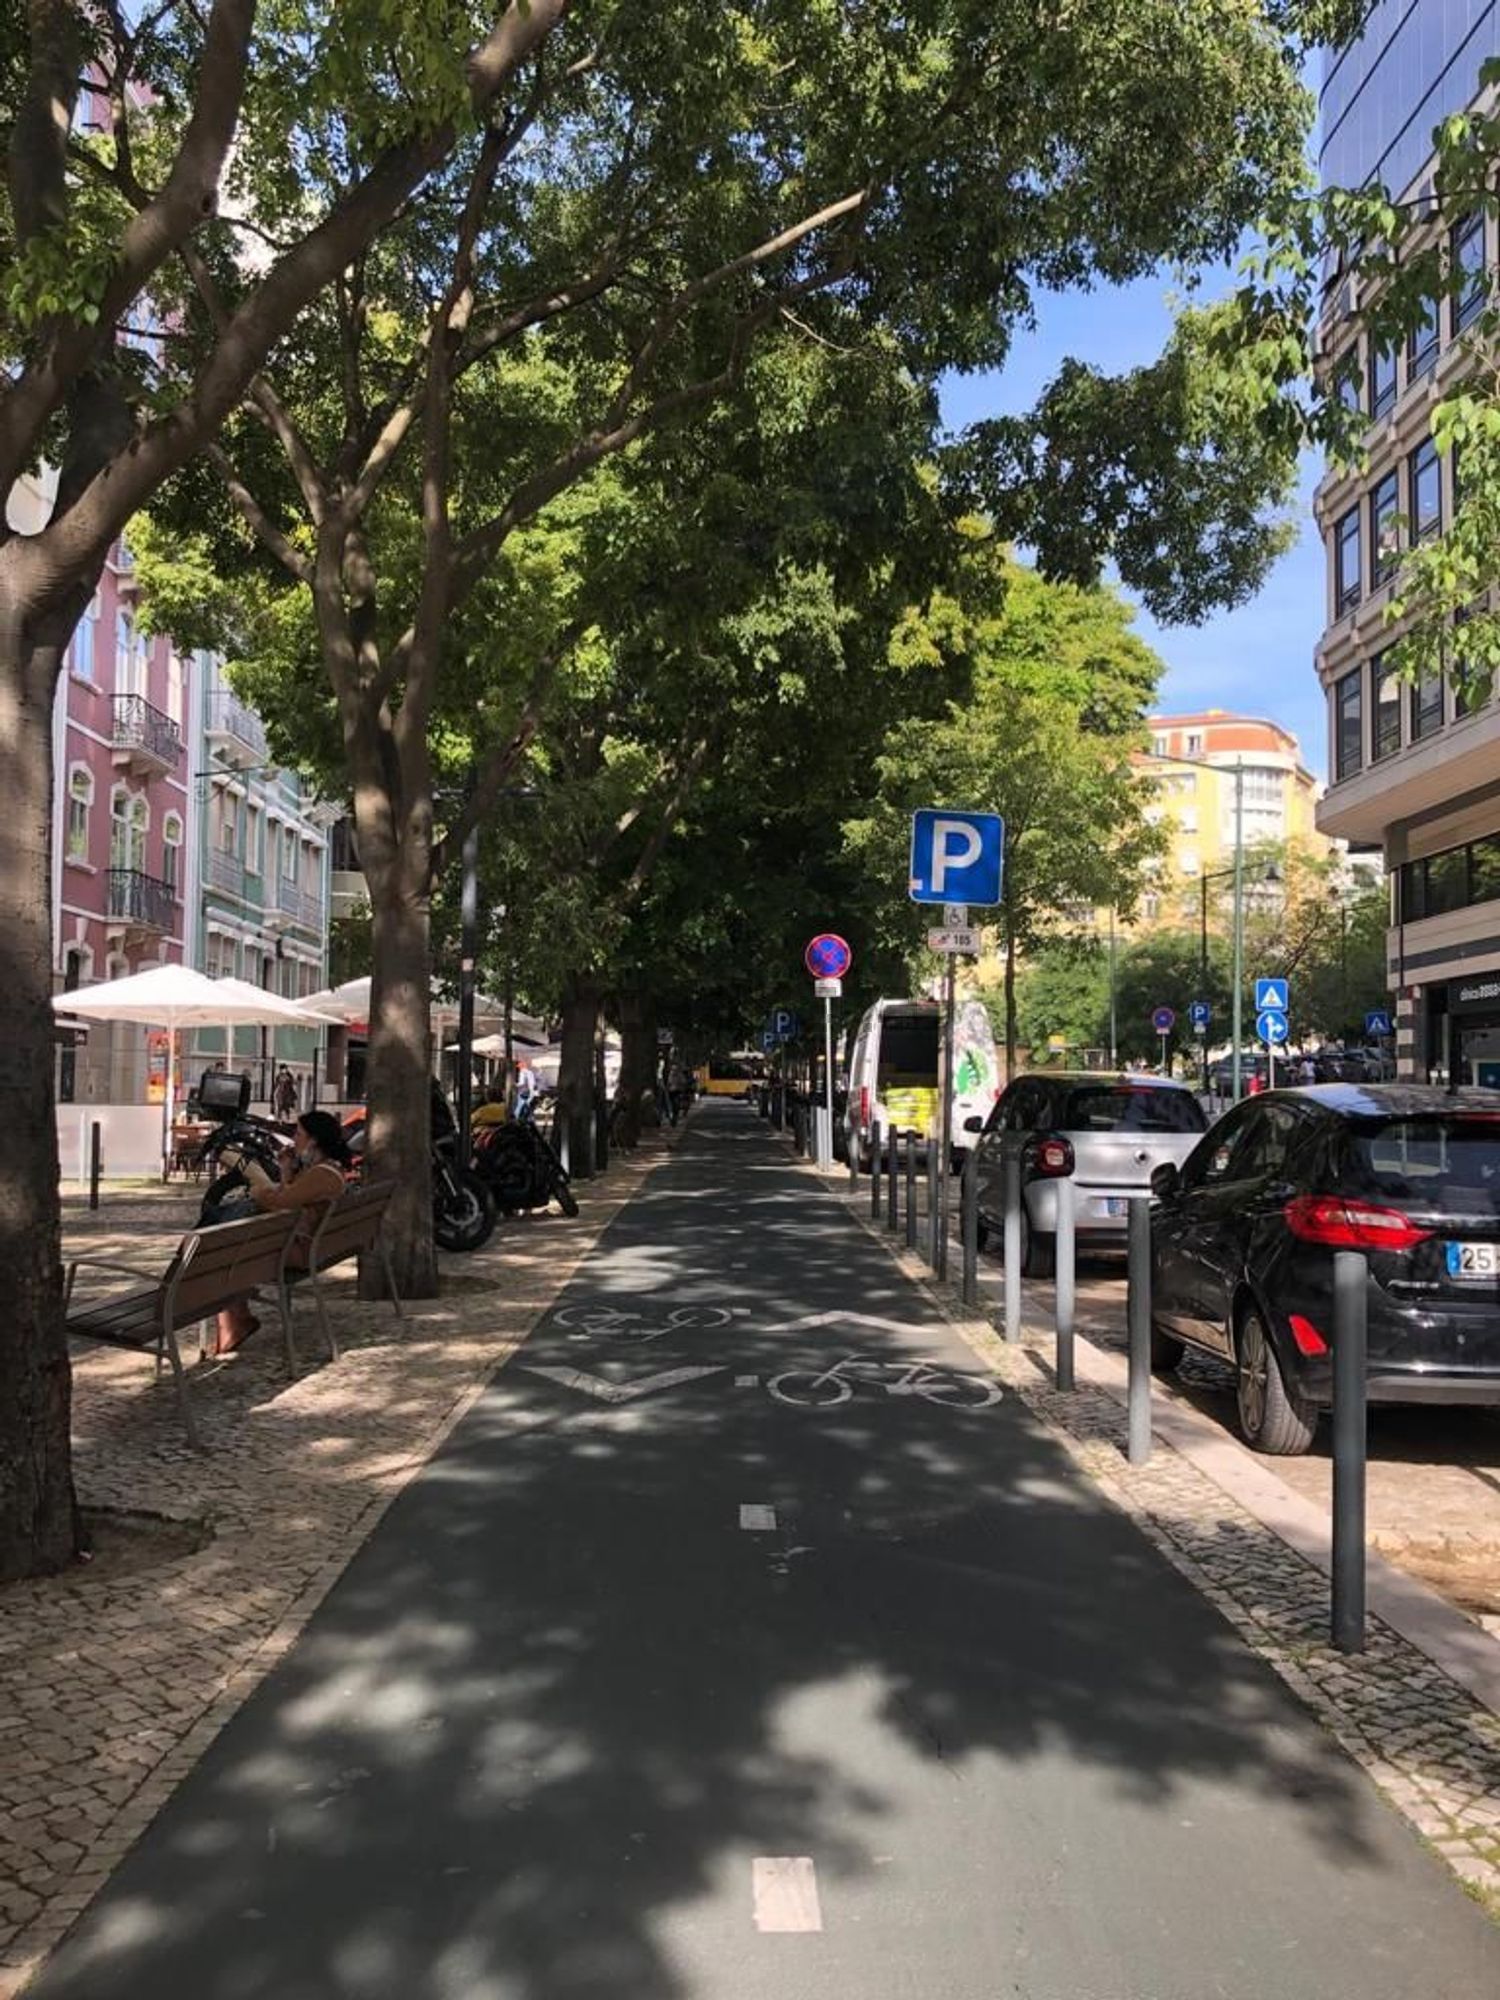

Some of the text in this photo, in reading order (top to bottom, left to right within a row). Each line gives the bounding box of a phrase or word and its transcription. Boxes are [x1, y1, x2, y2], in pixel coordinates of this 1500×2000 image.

[931, 819, 983, 892] P
[777, 1011, 791, 1033] P
[1194, 1006, 1205, 1019] P
